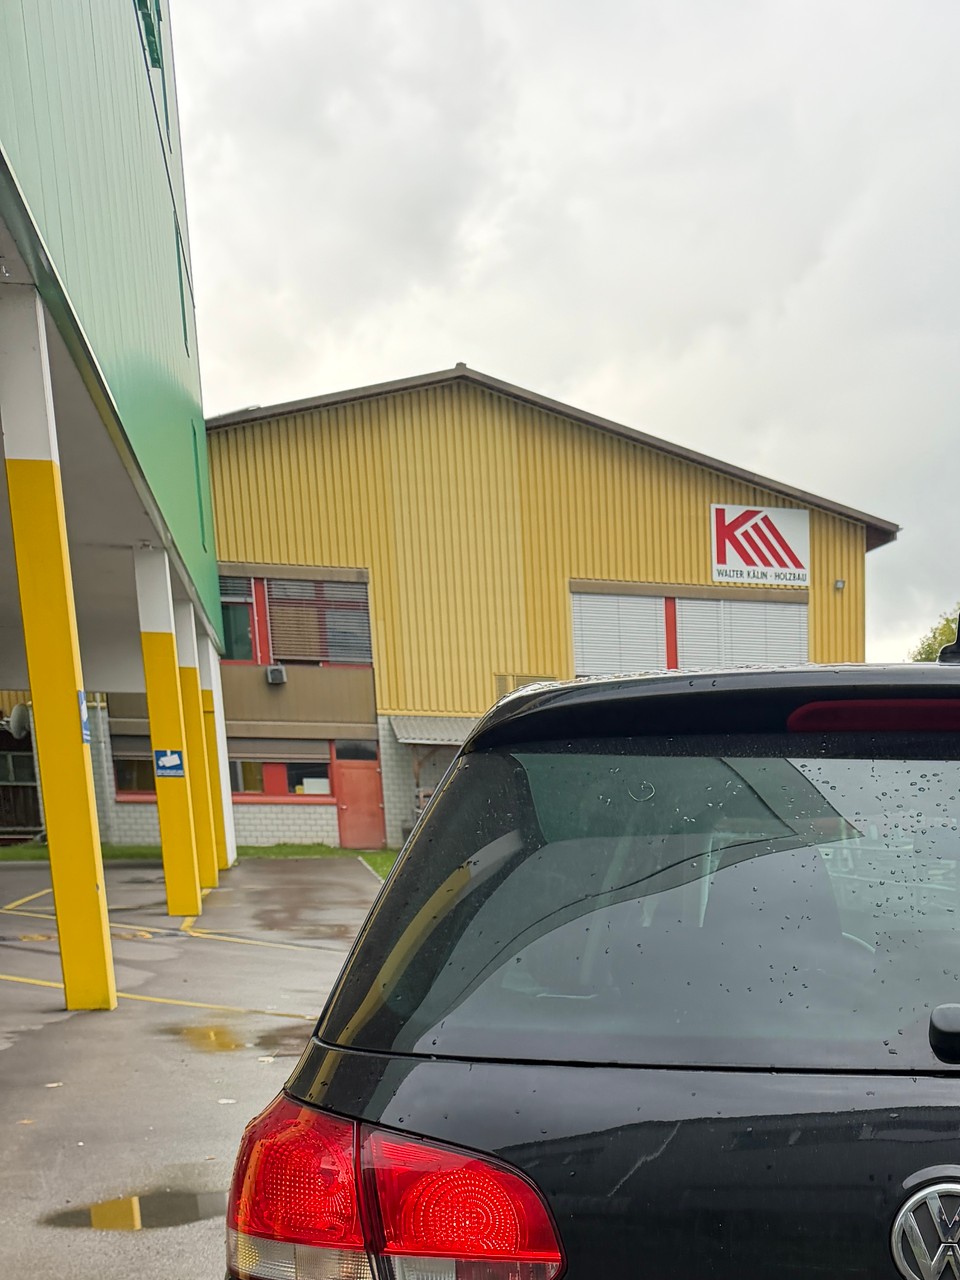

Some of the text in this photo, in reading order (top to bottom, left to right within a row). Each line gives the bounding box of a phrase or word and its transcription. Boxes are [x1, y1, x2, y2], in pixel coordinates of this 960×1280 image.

[716, 568, 745, 579] WALTER
[747, 569, 768, 580] KÄLIN
[774, 571, 807, 582] HOLZBAU
